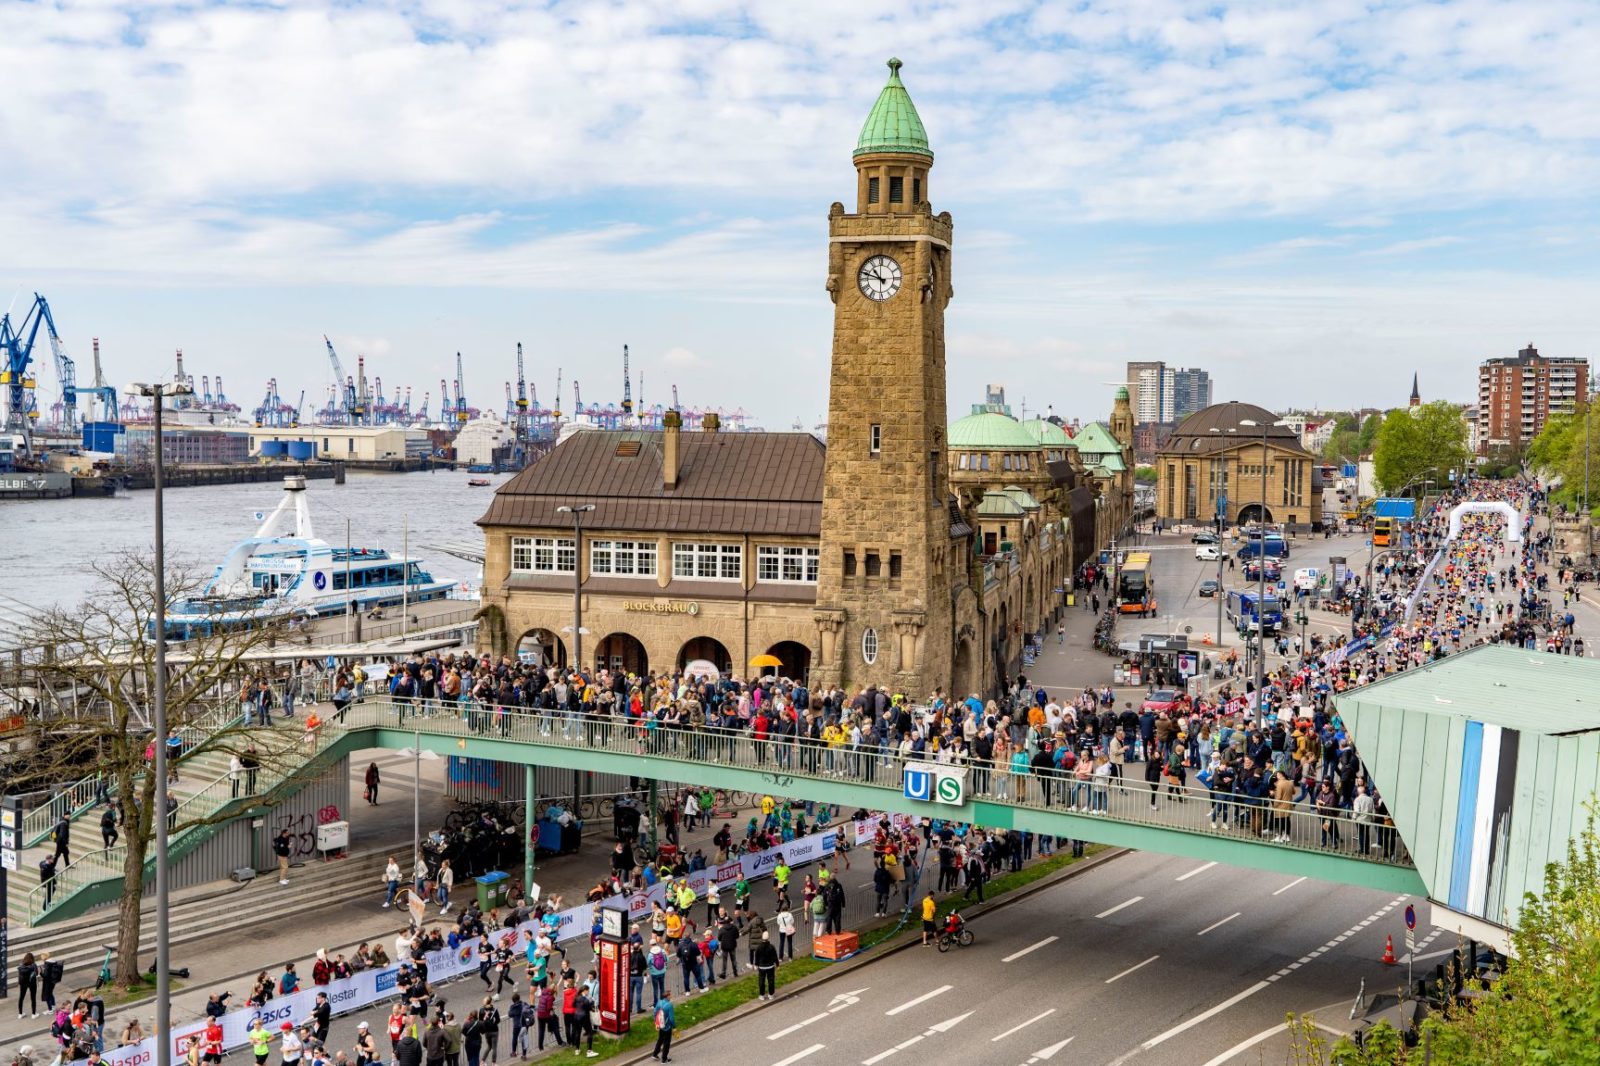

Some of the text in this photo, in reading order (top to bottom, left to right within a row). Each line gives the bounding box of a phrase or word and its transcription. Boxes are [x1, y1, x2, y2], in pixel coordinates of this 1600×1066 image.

[907, 771, 927, 798] U
[941, 779, 958, 801] S
[789, 844, 813, 858] Polestar
[761, 853, 775, 865] asic
[718, 863, 741, 881] REWE
[630, 898, 647, 912] LBS
[432, 960, 456, 973] DRUCK
